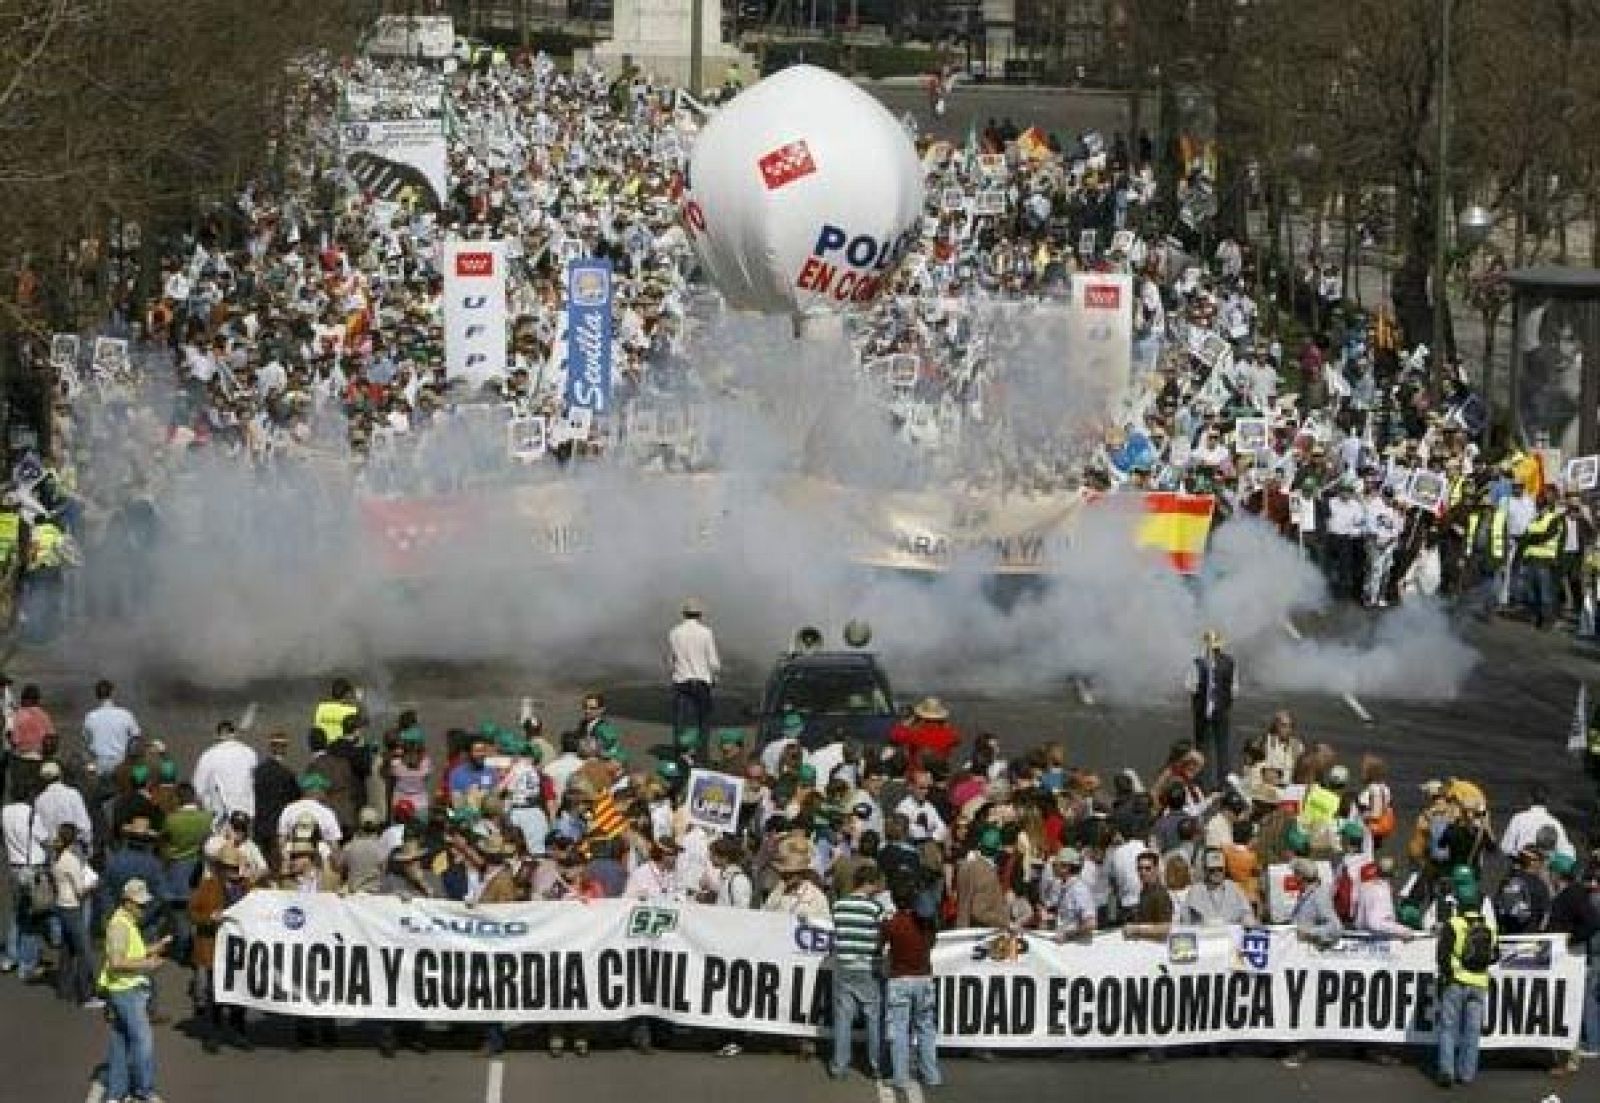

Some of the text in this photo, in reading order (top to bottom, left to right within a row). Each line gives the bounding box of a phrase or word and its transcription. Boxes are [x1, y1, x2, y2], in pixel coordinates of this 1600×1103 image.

[798, 257, 836, 293] EN
[572, 313, 604, 410] Sevilla
[379, 946, 405, 1007] Y
[413, 948, 588, 1011] GUARDIA
[598, 946, 691, 1012] CIVIL
[702, 953, 780, 1021] POR
[790, 965, 833, 1026] LA
[934, 974, 1037, 1036] IDAD
[1285, 969, 1308, 1029] Y
